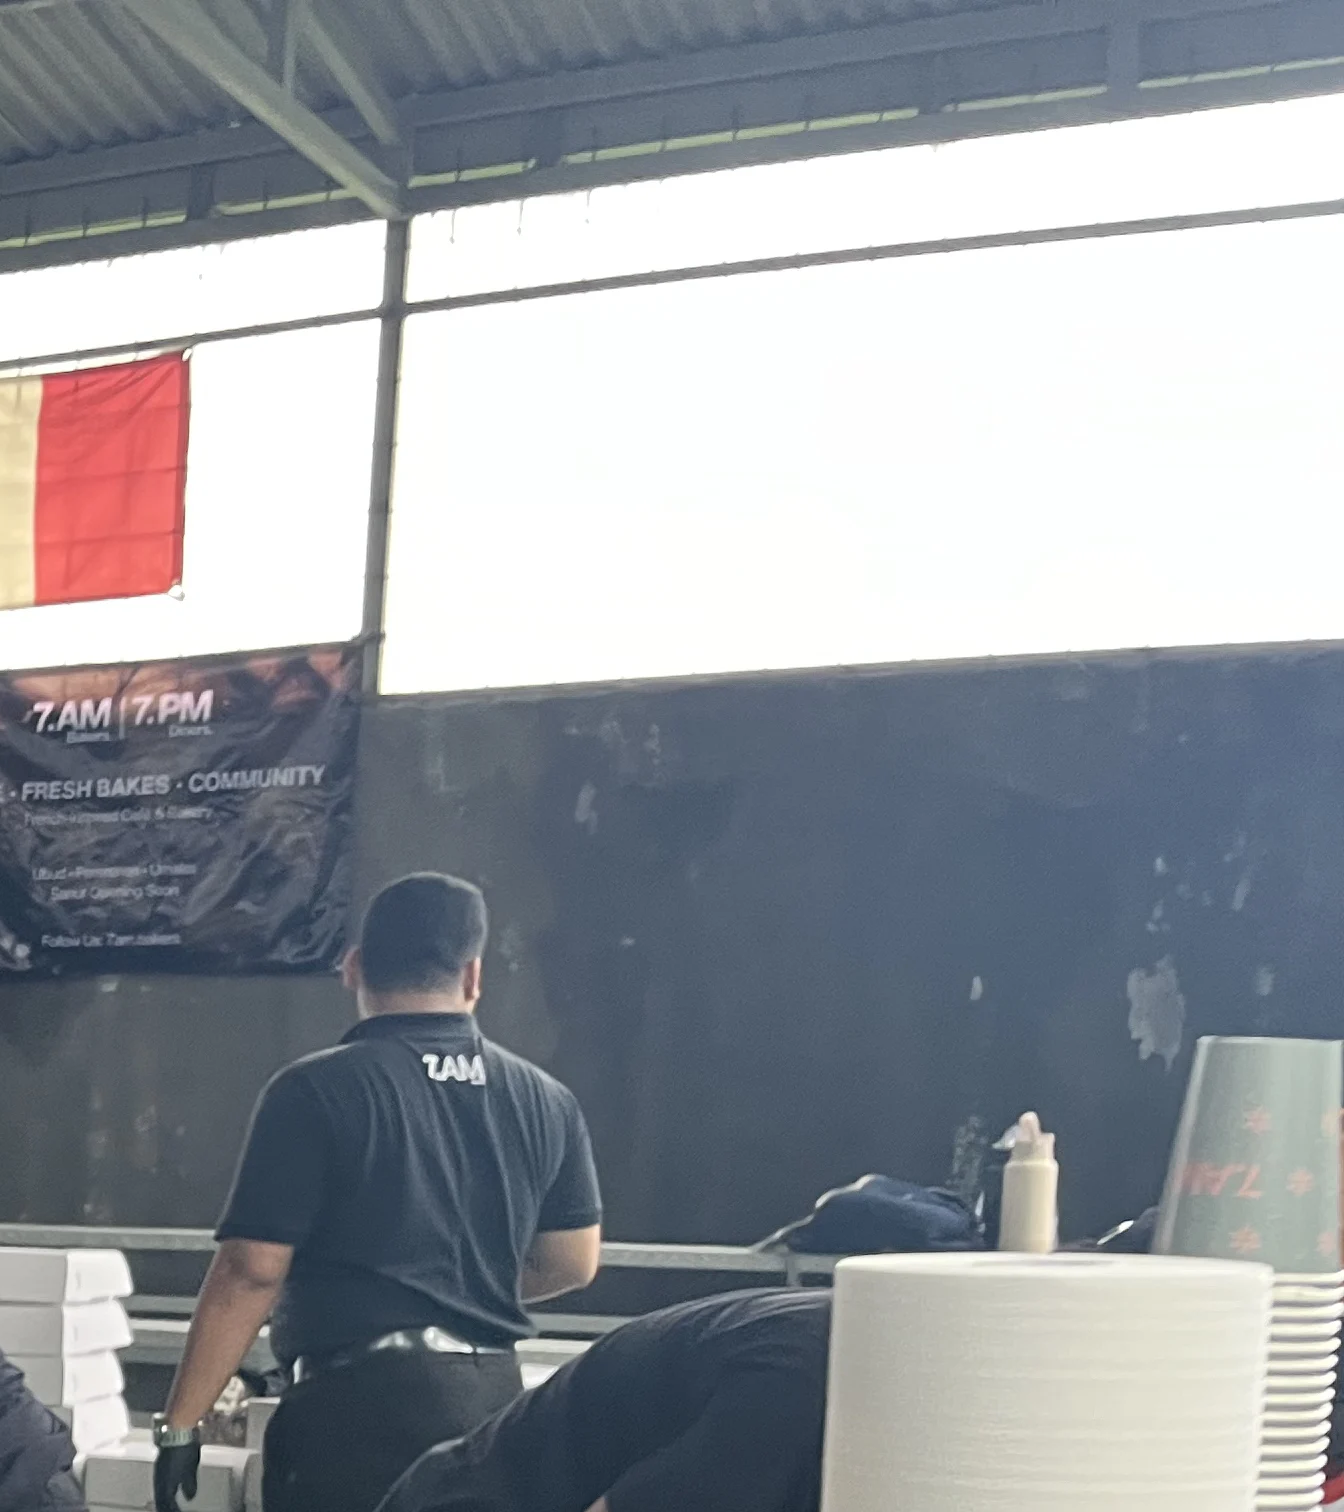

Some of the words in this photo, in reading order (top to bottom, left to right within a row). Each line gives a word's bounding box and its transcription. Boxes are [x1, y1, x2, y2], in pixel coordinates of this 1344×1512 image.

[32, 697, 111, 733] 7.AM
[134, 690, 214, 726] 7.PM
[21, 777, 93, 802] FRESH
[97, 774, 169, 798] BAKES
[189, 765, 325, 793] COMMUNITY
